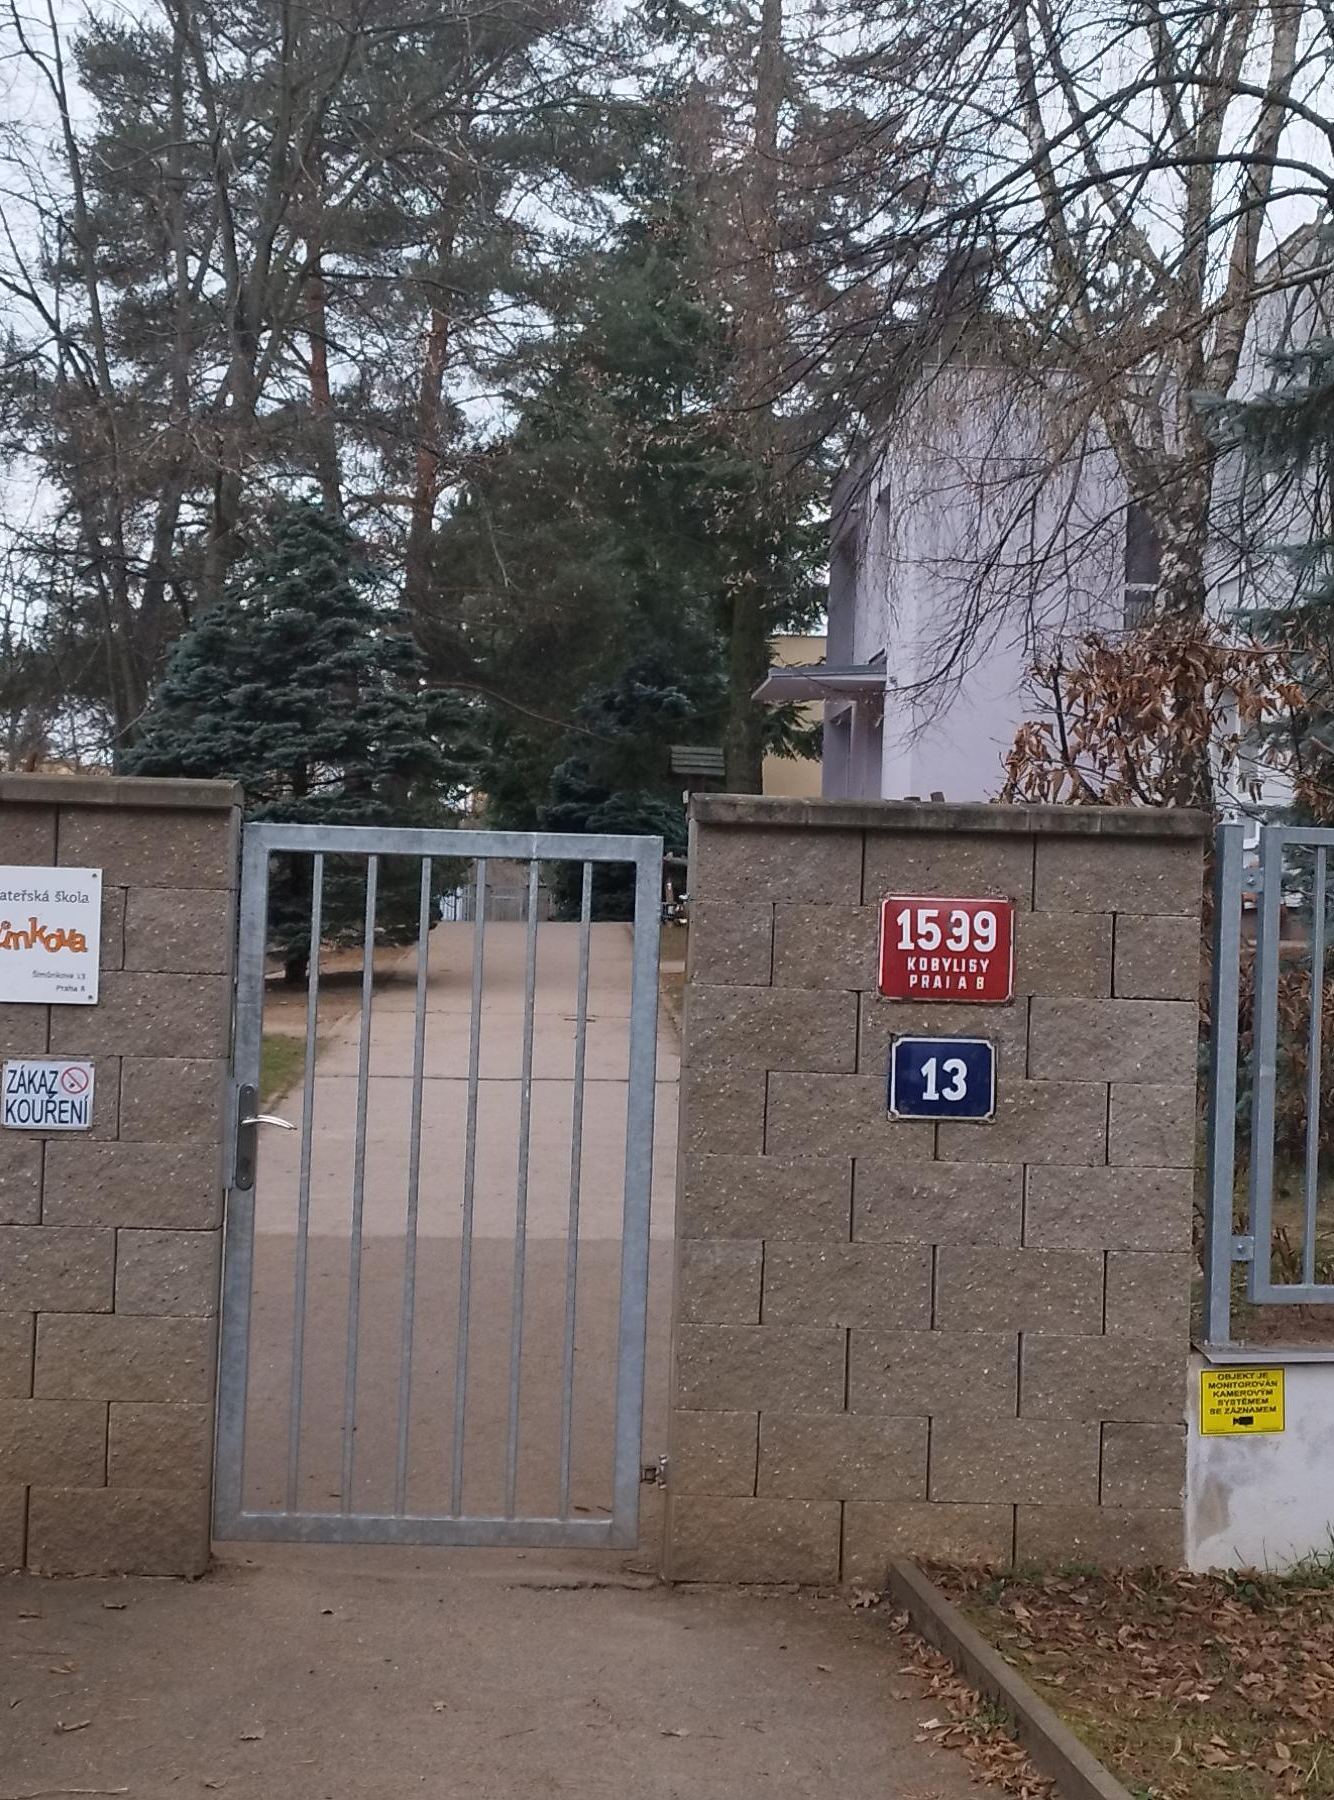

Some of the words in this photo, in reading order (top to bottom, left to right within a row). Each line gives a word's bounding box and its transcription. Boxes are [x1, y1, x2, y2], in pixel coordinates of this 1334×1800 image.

[54, 890, 89, 904] škola
[907, 956, 990, 973] KOBYLISY
[7, 1064, 58, 1094] ZÁKAZ
[920, 1057, 968, 1101] 13
[5, 1092, 89, 1125] KOUŘENÍ
